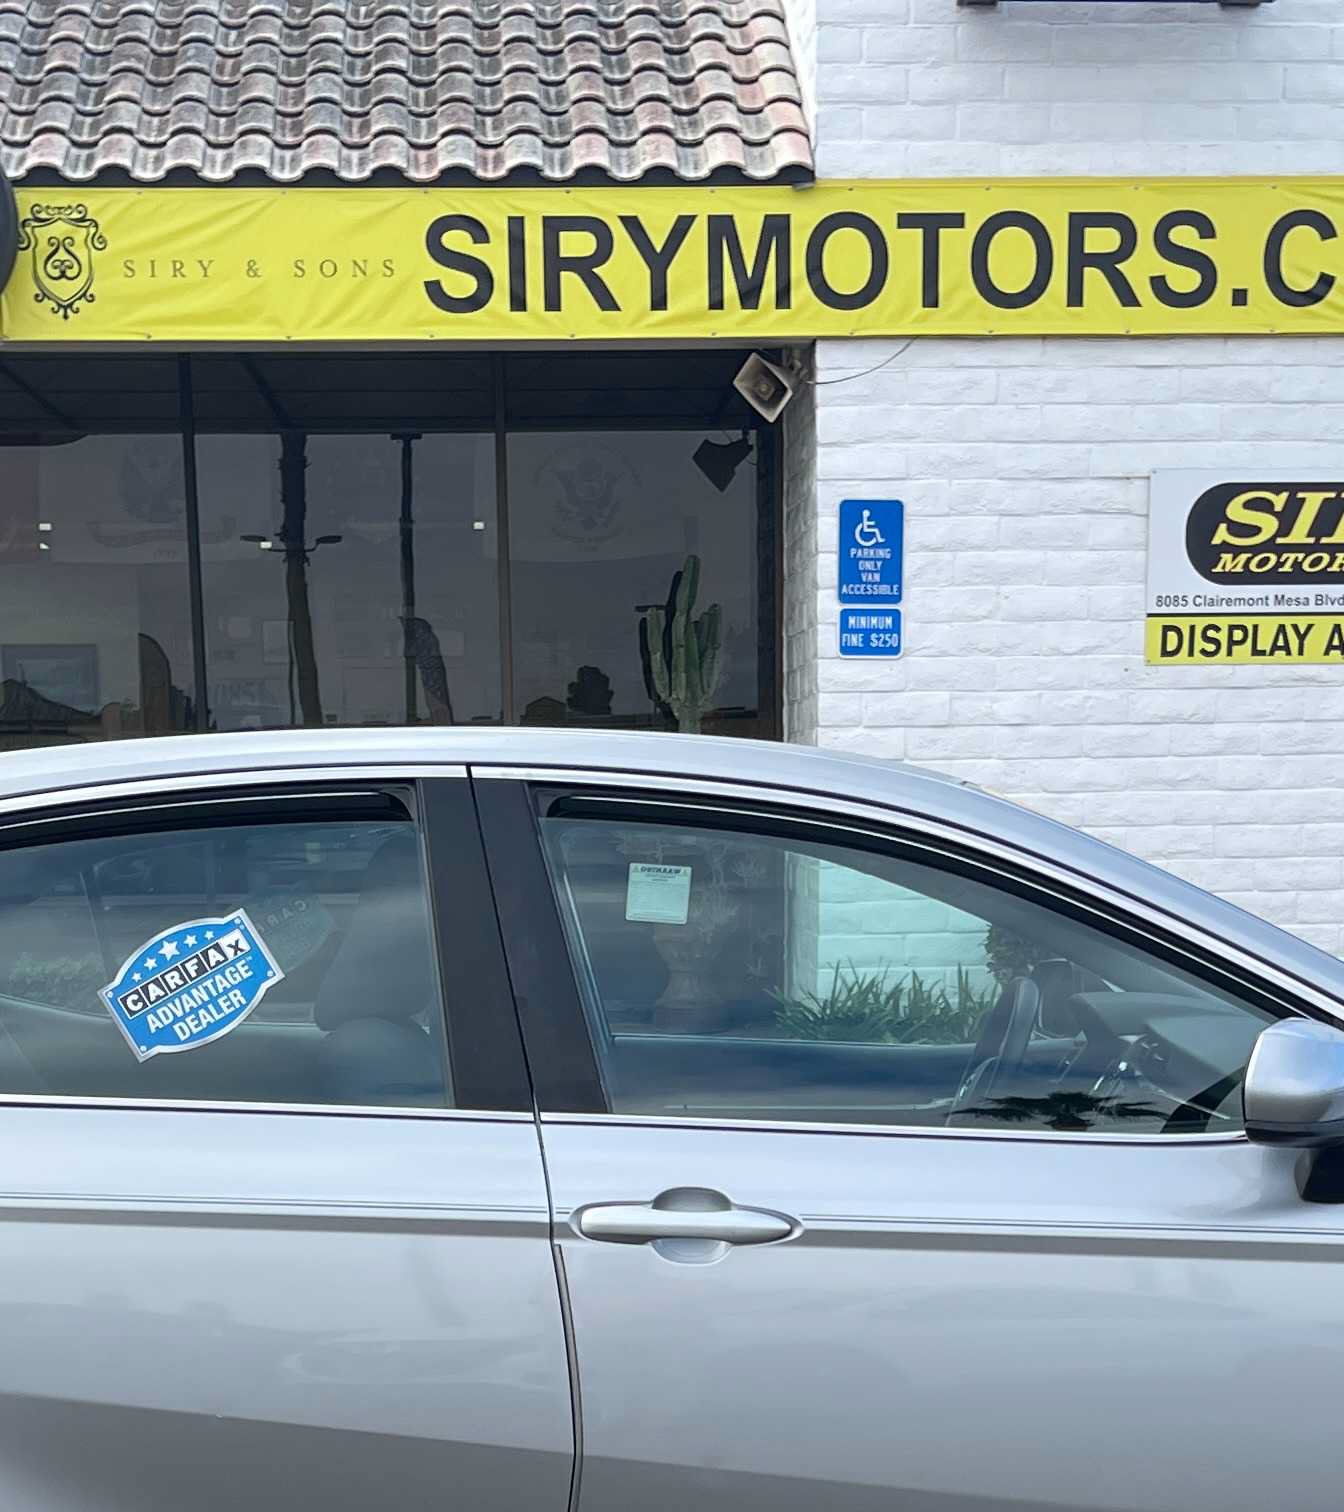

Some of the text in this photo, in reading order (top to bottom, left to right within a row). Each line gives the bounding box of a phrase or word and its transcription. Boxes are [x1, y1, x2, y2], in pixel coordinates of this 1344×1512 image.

[123, 258, 396, 280] SIRY & SONS
[850, 547, 891, 560] PARKING
[858, 560, 882, 571] ONLY
[861, 572, 881, 583] VAN
[841, 584, 899, 596] ACCESSIBLE
[1155, 594, 1189, 608] 8085
[1192, 593, 1270, 608] Clairemont
[1274, 593, 1310, 607] Mesa
[848, 616, 893, 629] MINIMUM
[842, 632, 899, 648] FINE $250
[1160, 623, 1315, 658] DISPLAY
[122, 934, 249, 1014] CARFAX
[146, 960, 254, 1033] ADVANTAGE
[173, 988, 247, 1042] DEALER
